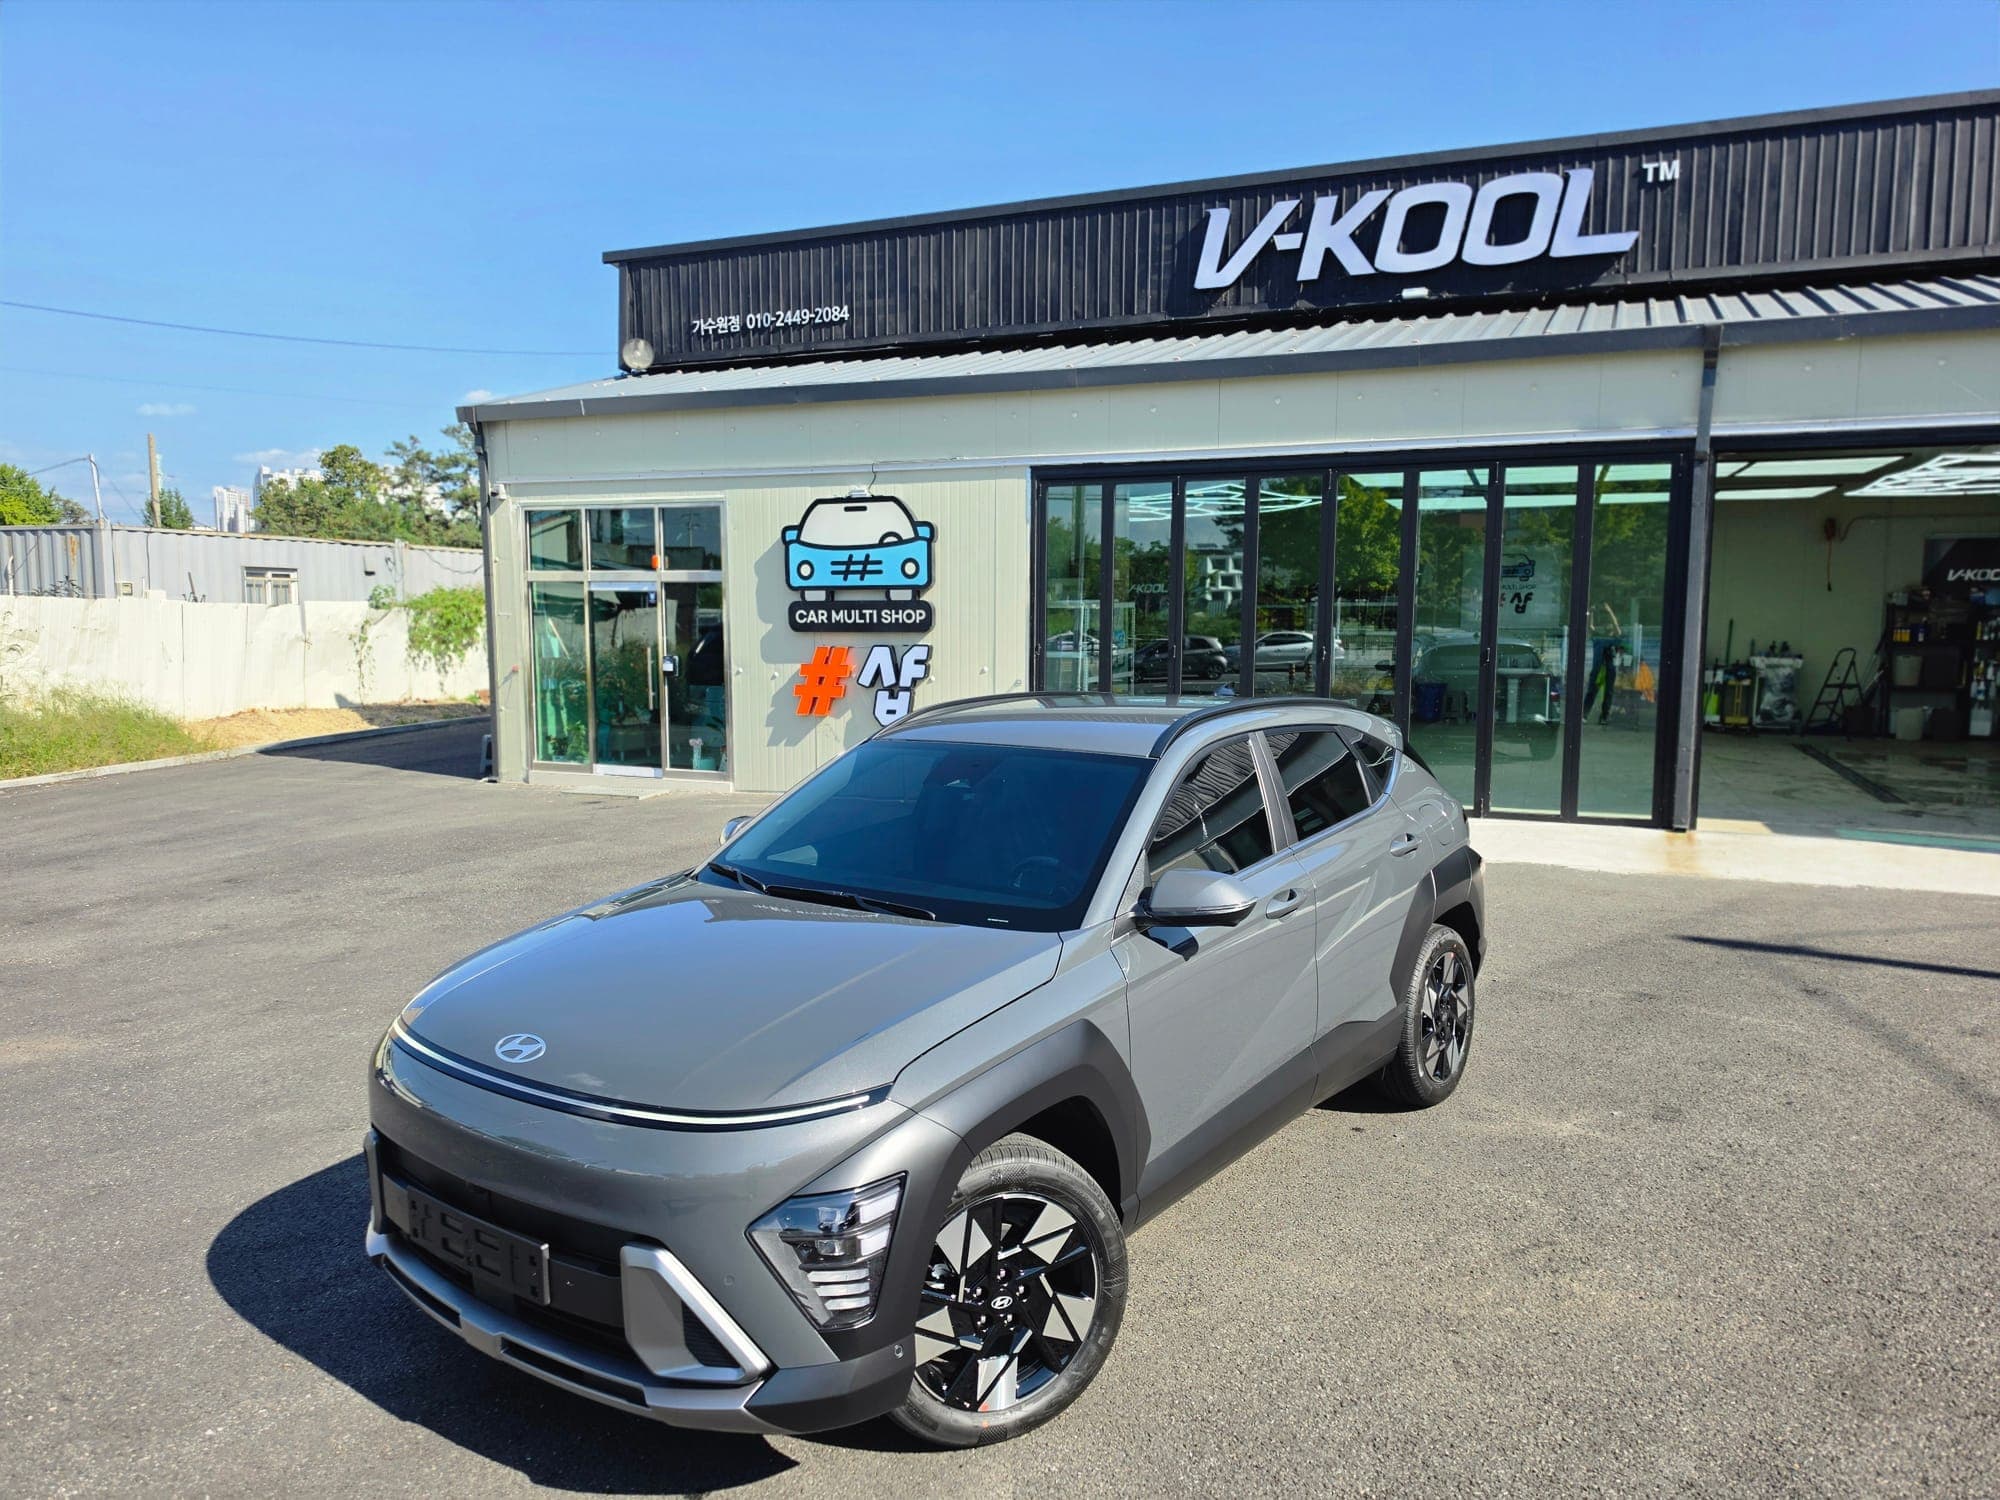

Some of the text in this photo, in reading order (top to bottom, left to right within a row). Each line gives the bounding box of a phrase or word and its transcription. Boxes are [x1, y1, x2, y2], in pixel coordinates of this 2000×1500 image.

[1642, 160, 1680, 182] TM
[1194, 168, 1639, 290] V-KOOL
[692, 305, 850, 335] 가수원점 010-2449-2084
[795, 608, 926, 624] CAR MULTI SHOP
